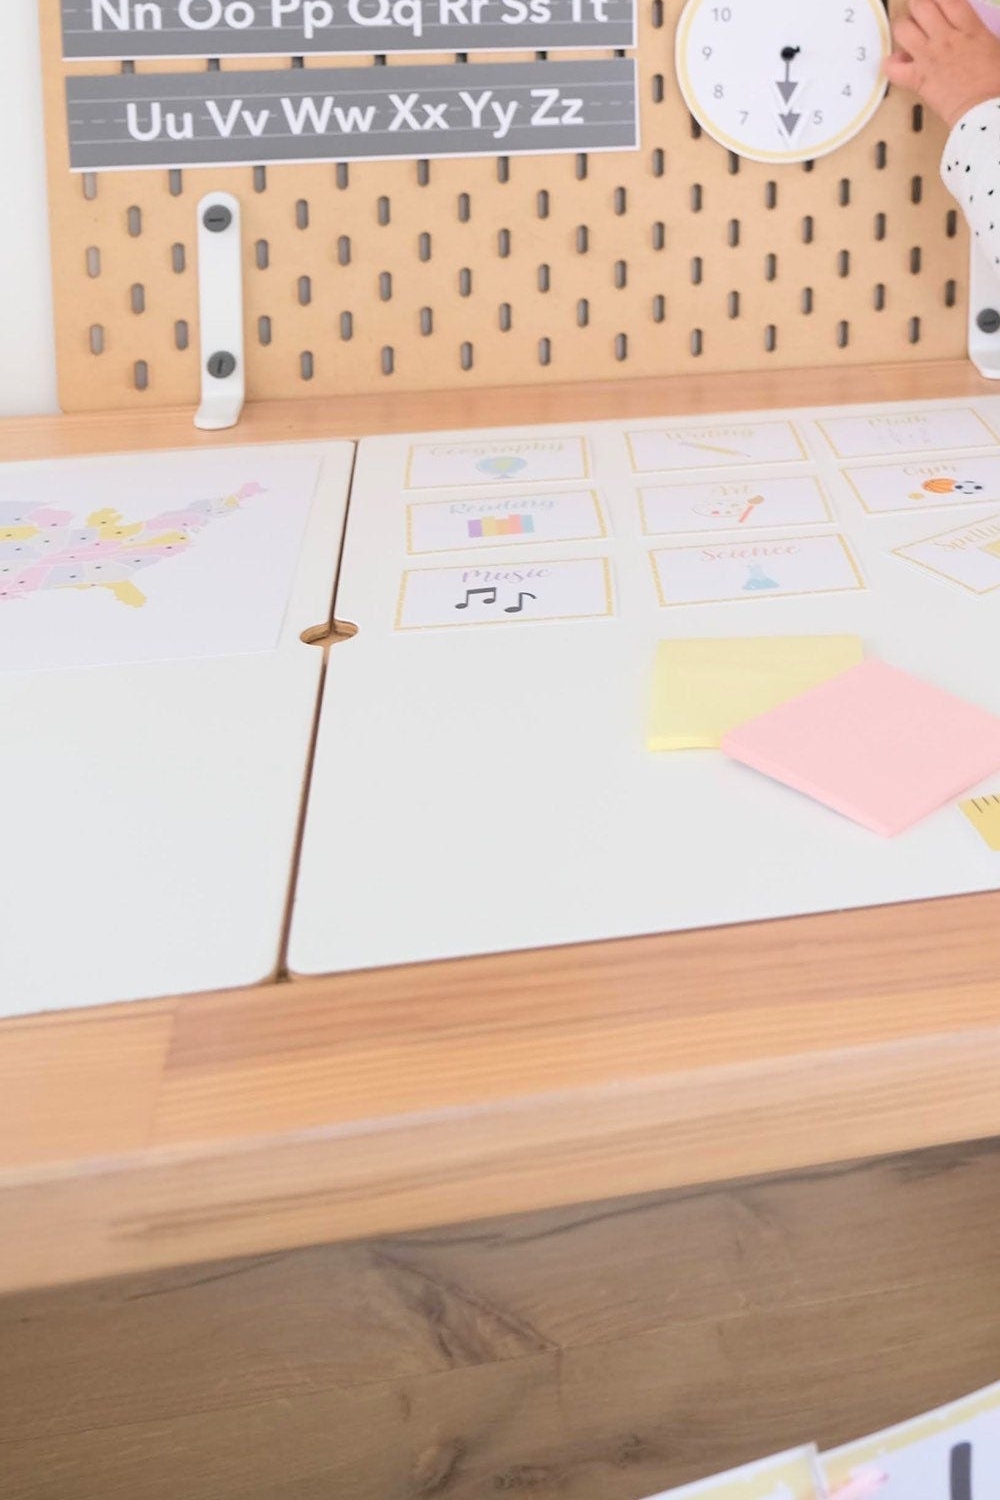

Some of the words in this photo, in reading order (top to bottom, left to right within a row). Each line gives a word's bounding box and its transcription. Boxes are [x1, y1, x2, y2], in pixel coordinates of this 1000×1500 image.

[713, 8, 732, 22] 10
[845, 8, 854, 23] 2
[702, 46, 712, 60] 9
[857, 48, 866, 61] 3
[714, 85, 723, 99] 8
[842, 85, 851, 97] 4
[126, 102, 194, 141] Uu
[206, 99, 269, 138] Vv
[281, 97, 375, 135] Ww
[389, 94, 449, 131] Xx
[460, 91, 518, 138] Yy
[530, 89, 584, 126] Zz
[740, 112, 749, 125] 7
[814, 111, 823, 125] 5
[902, 464, 959, 478] Gym
[711, 483, 751, 496] Art
[449, 498, 557, 514] Reading
[701, 544, 799, 562] Science
[461, 567, 553, 584] Music
